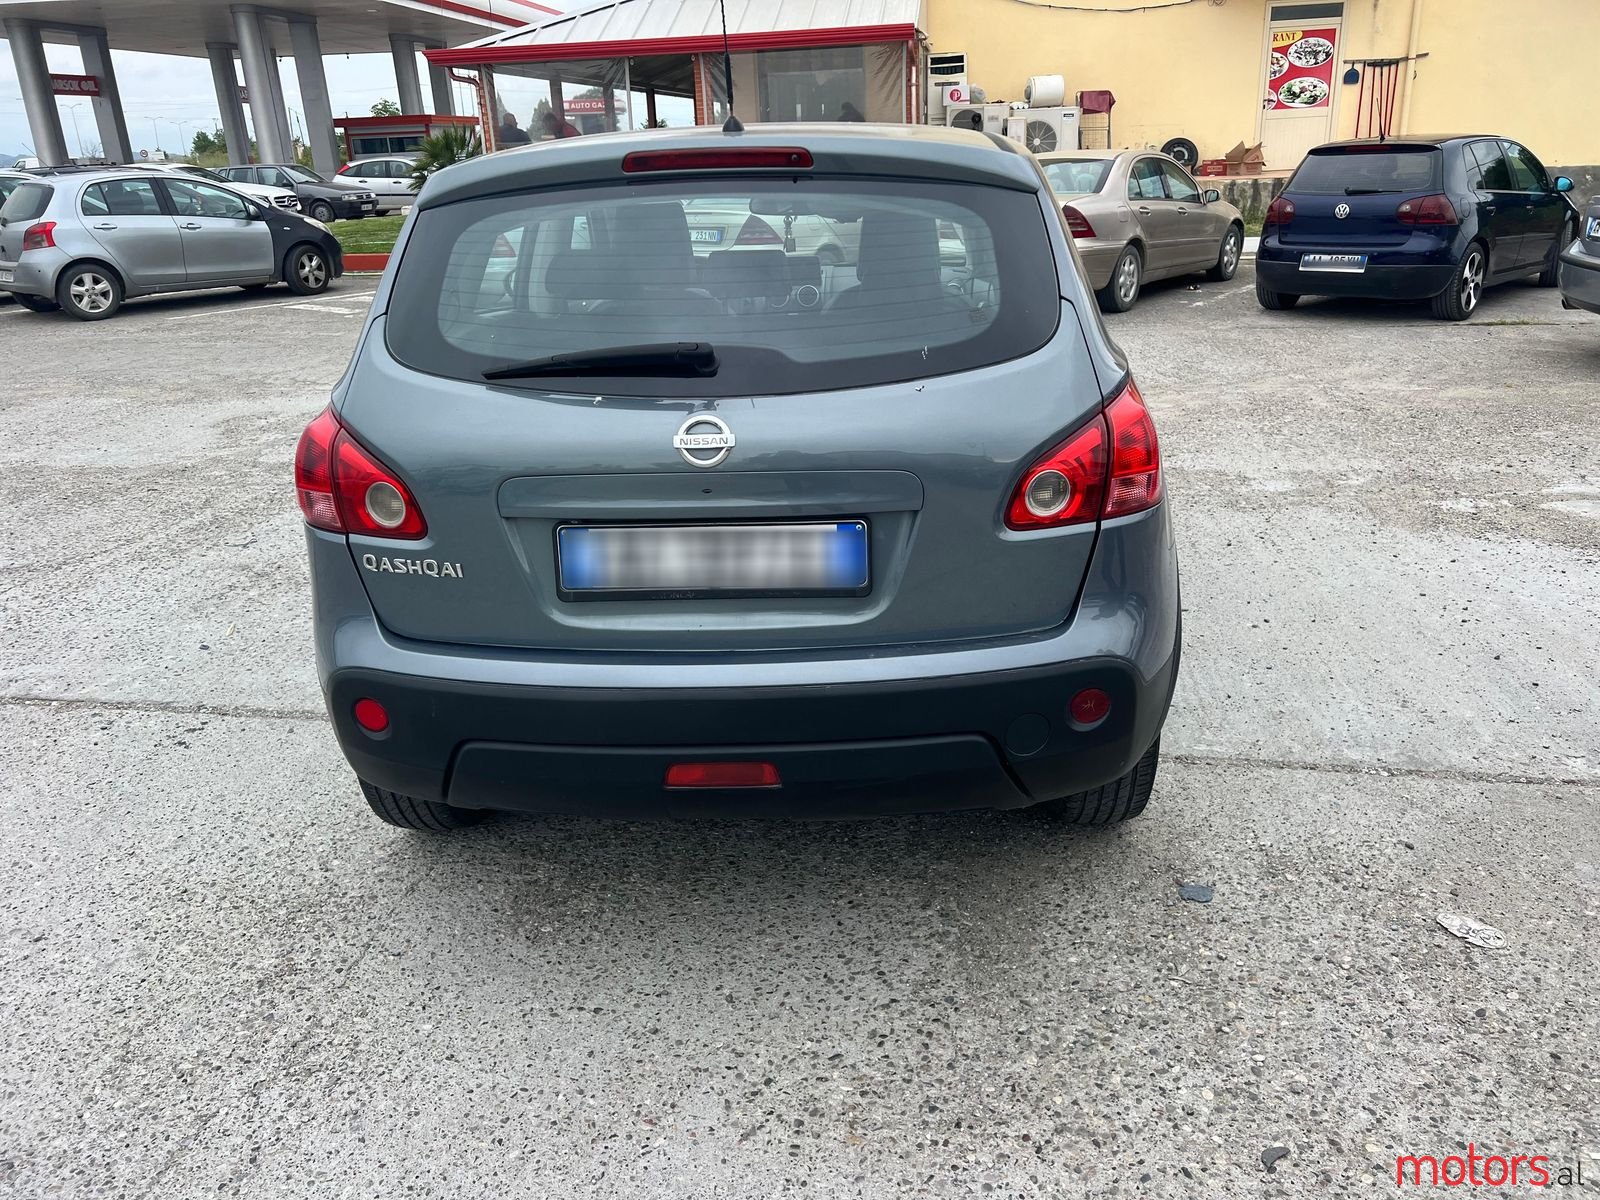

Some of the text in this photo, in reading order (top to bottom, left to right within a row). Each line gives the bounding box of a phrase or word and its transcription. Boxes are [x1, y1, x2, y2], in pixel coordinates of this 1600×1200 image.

[1273, 32, 1297, 42] RANT
[679, 436, 728, 446] NISSAN
[362, 553, 464, 578] QASHQAI
